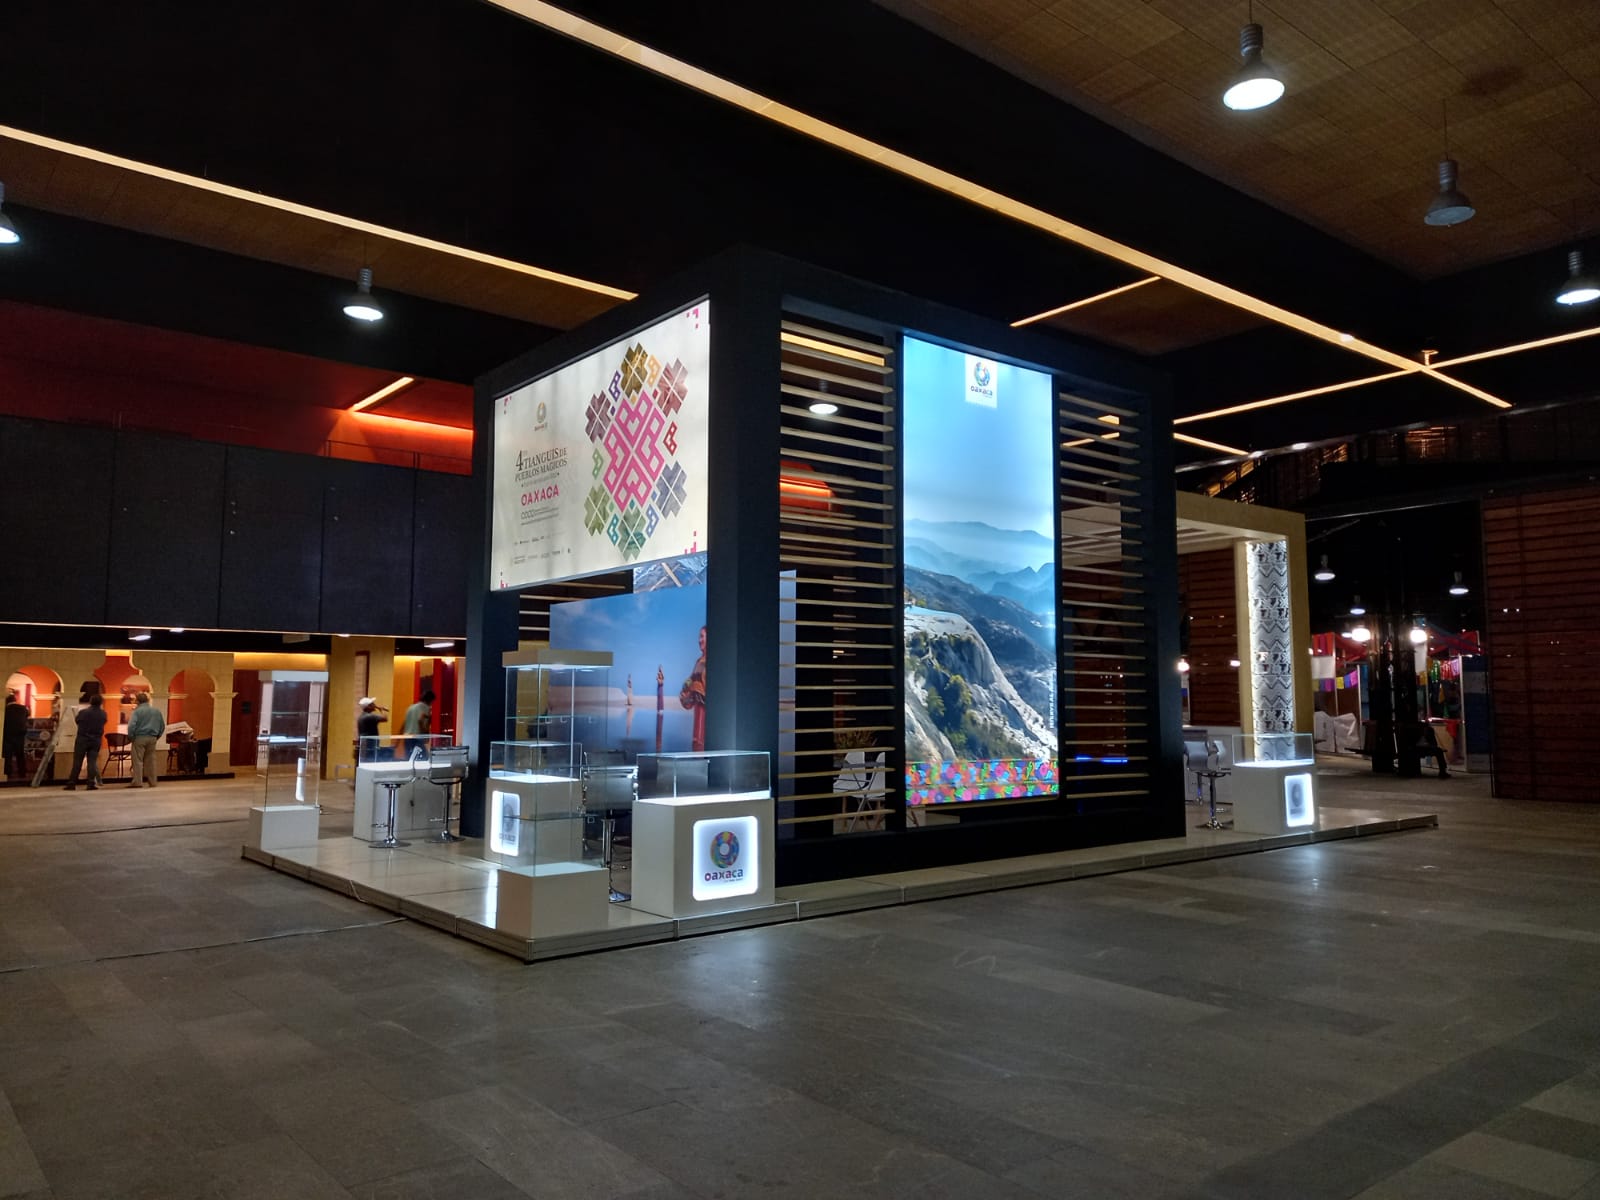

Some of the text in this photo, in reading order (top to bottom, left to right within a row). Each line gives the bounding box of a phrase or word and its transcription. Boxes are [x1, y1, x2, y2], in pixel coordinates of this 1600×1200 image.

[523, 448, 559, 469] TIANGUIS
[559, 448, 567, 458] DE
[515, 467, 540, 481] PUEBLOS
[521, 484, 559, 506] OAXACA
[704, 868, 744, 881] oaxaca
